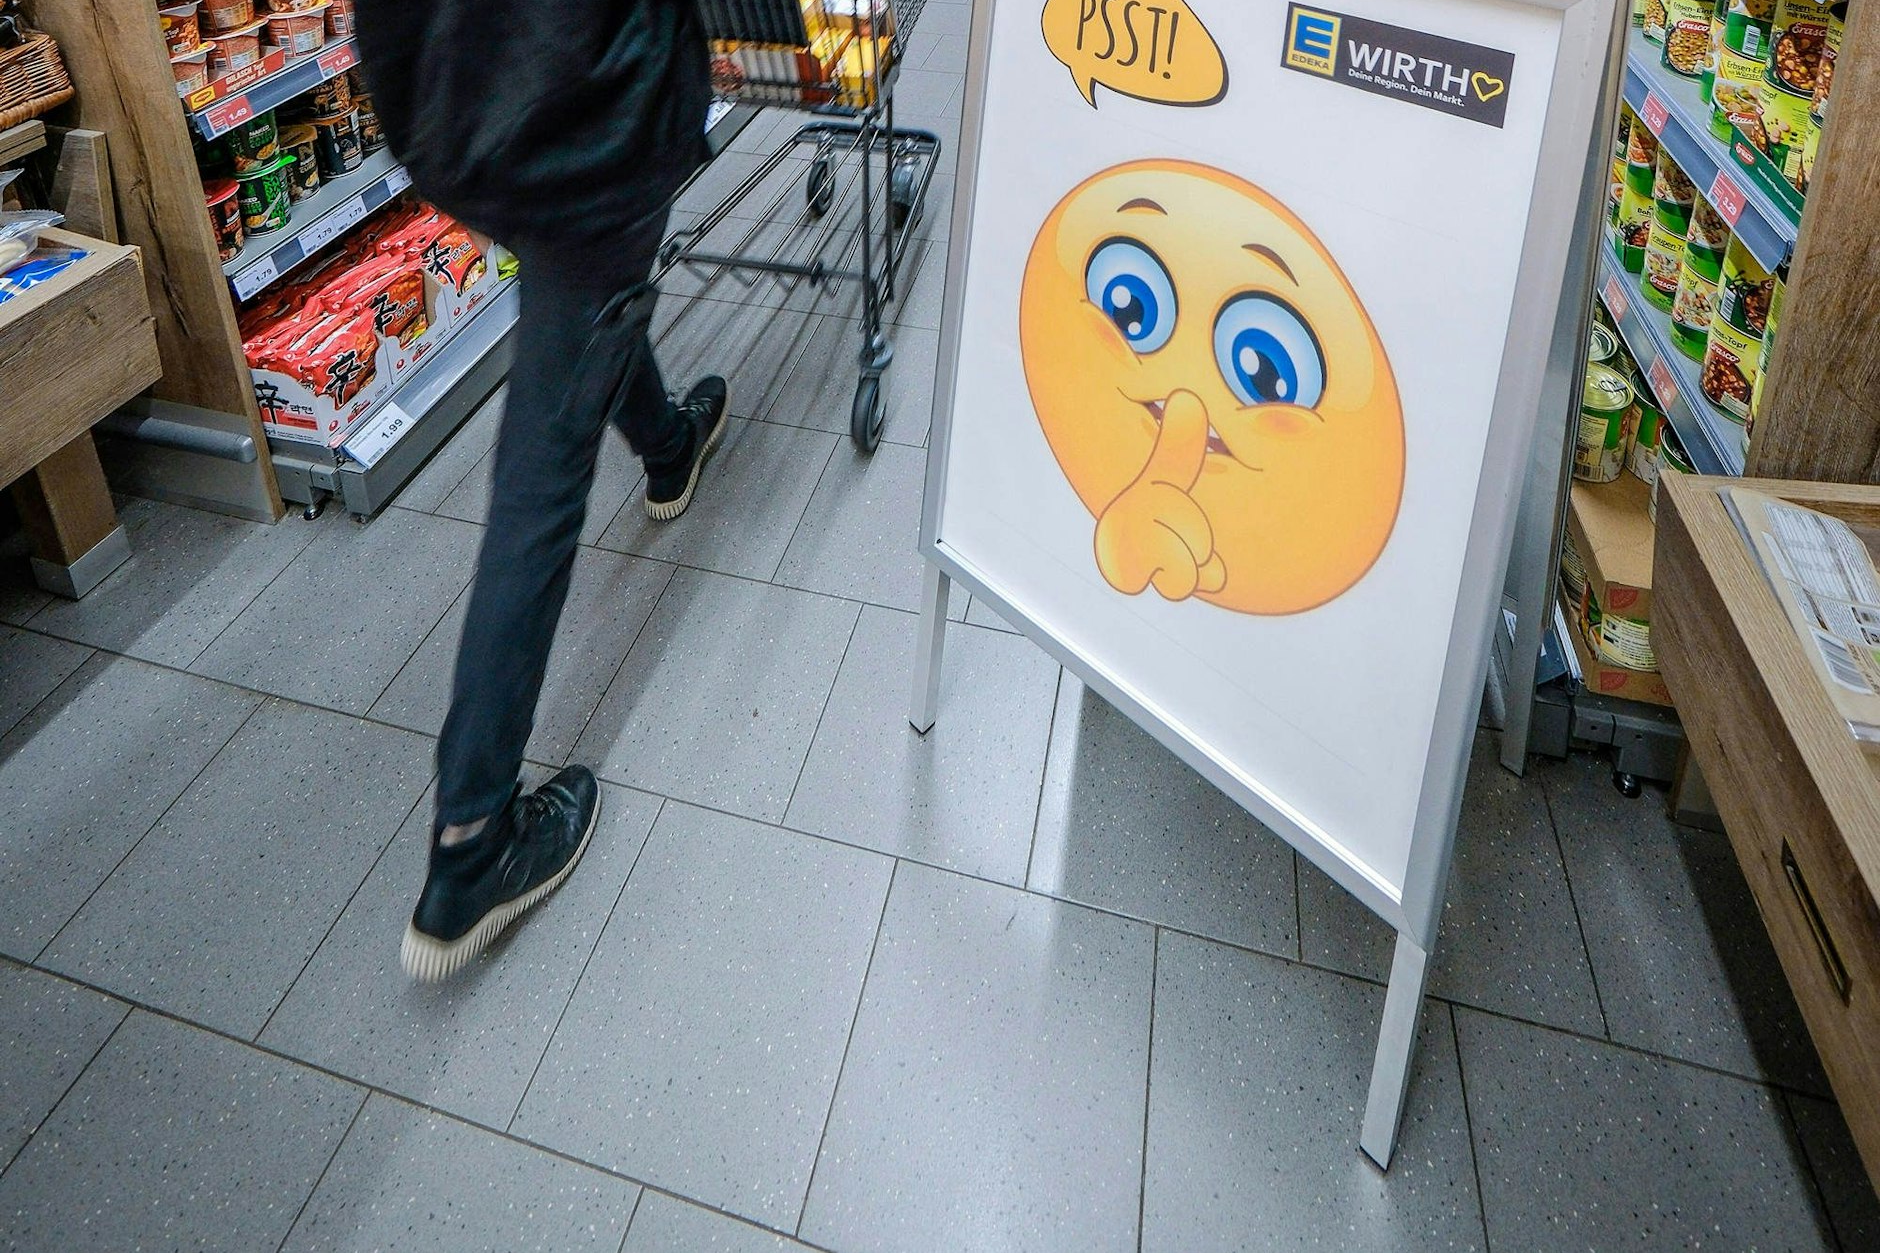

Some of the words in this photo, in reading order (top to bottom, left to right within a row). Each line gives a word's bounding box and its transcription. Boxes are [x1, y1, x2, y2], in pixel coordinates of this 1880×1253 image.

[335, 55, 350, 66] 1.49
[1291, 53, 1330, 71] EDEKA
[1348, 39, 1470, 97] WIRTH
[1348, 68, 1373, 83] Deine
[1374, 75, 1408, 92] Region.
[1410, 84, 1433, 97] Dein
[1433, 90, 1465, 107] Markt.
[228, 108, 247, 120] 1.49
[348, 207, 362, 219] 1.79
[1722, 197, 1736, 216] 3.29
[317, 228, 332, 241] 1.79
[255, 268, 272, 283] 1.79
[255, 380, 290, 425] 辛
[381, 418, 403, 439] 1.99
